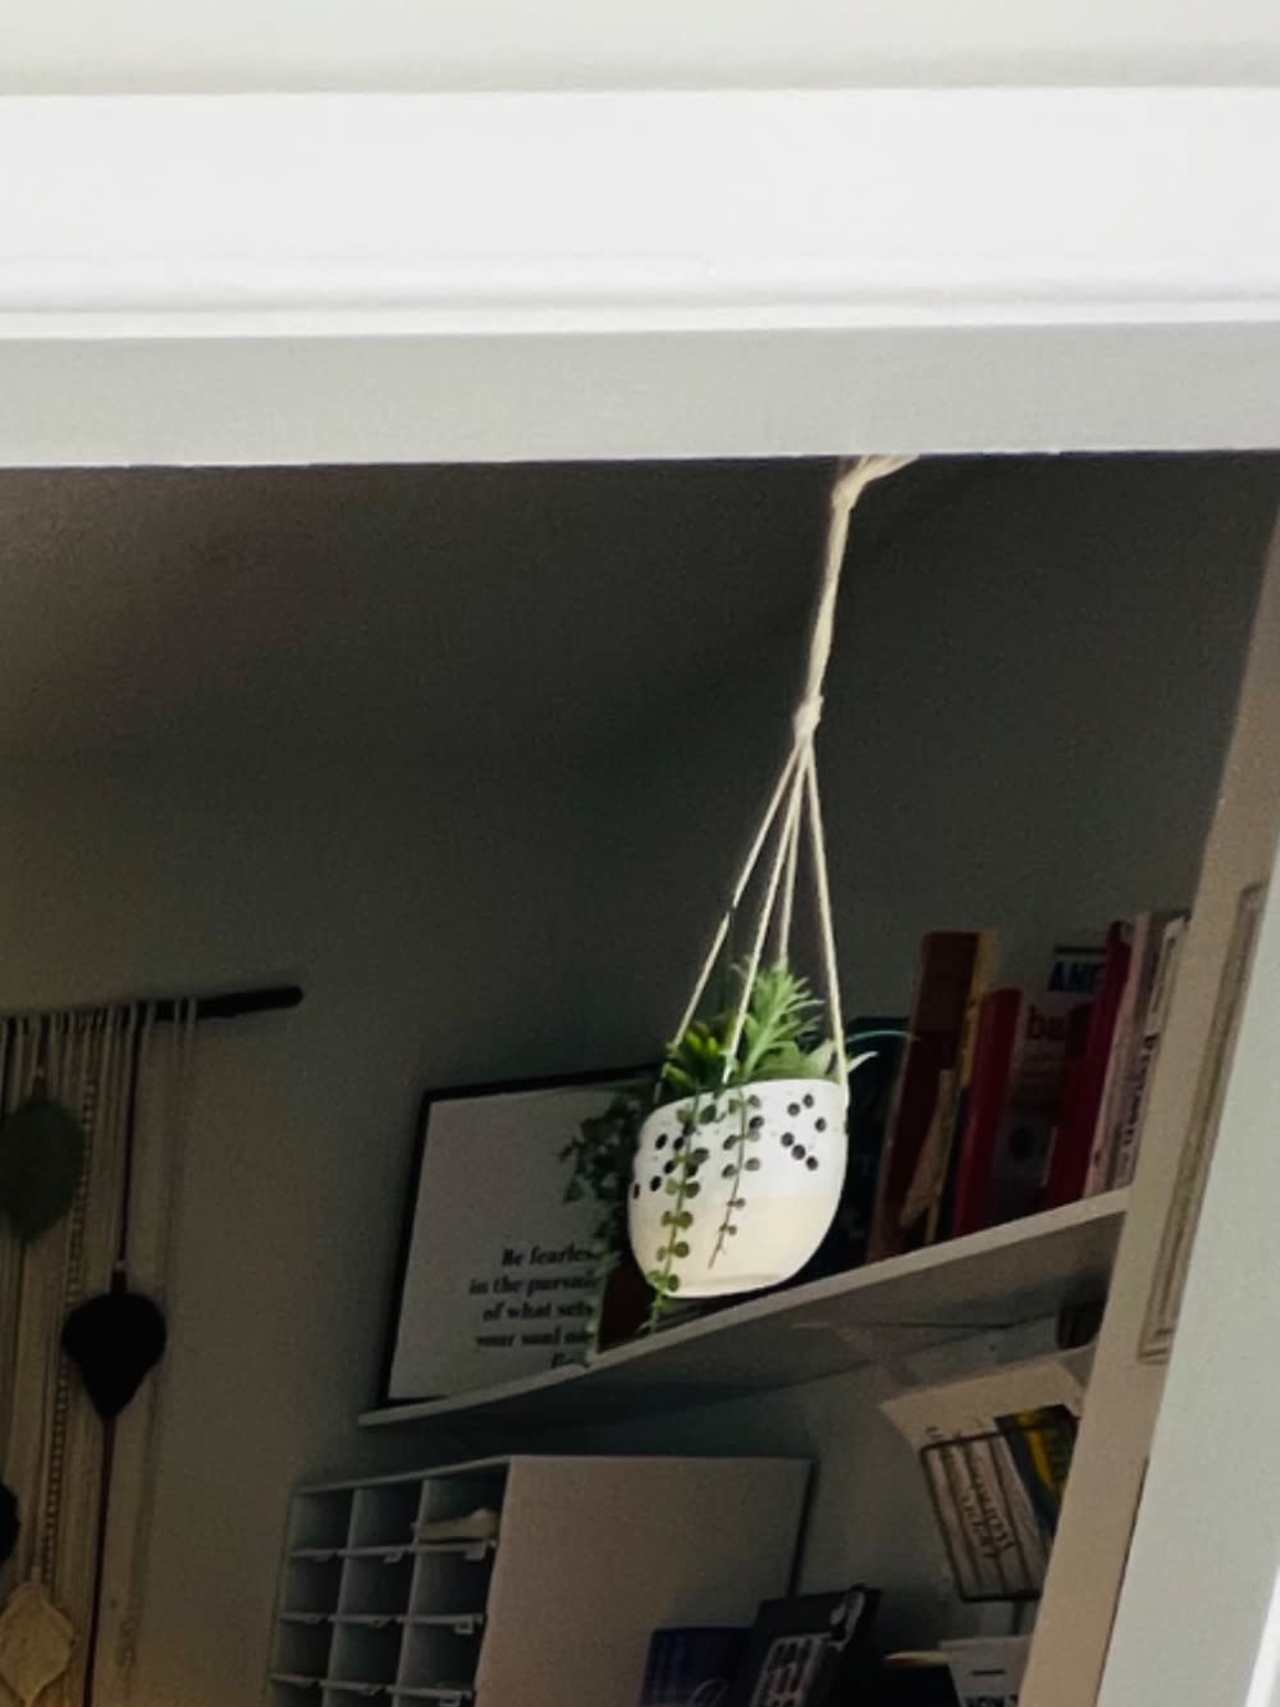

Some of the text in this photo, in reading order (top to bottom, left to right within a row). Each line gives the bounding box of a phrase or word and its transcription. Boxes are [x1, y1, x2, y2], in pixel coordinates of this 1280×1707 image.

[502, 1248, 522, 1266] Be
[493, 1276, 522, 1294] the
[483, 1302, 506, 1322] of
[507, 1302, 552, 1321] what
